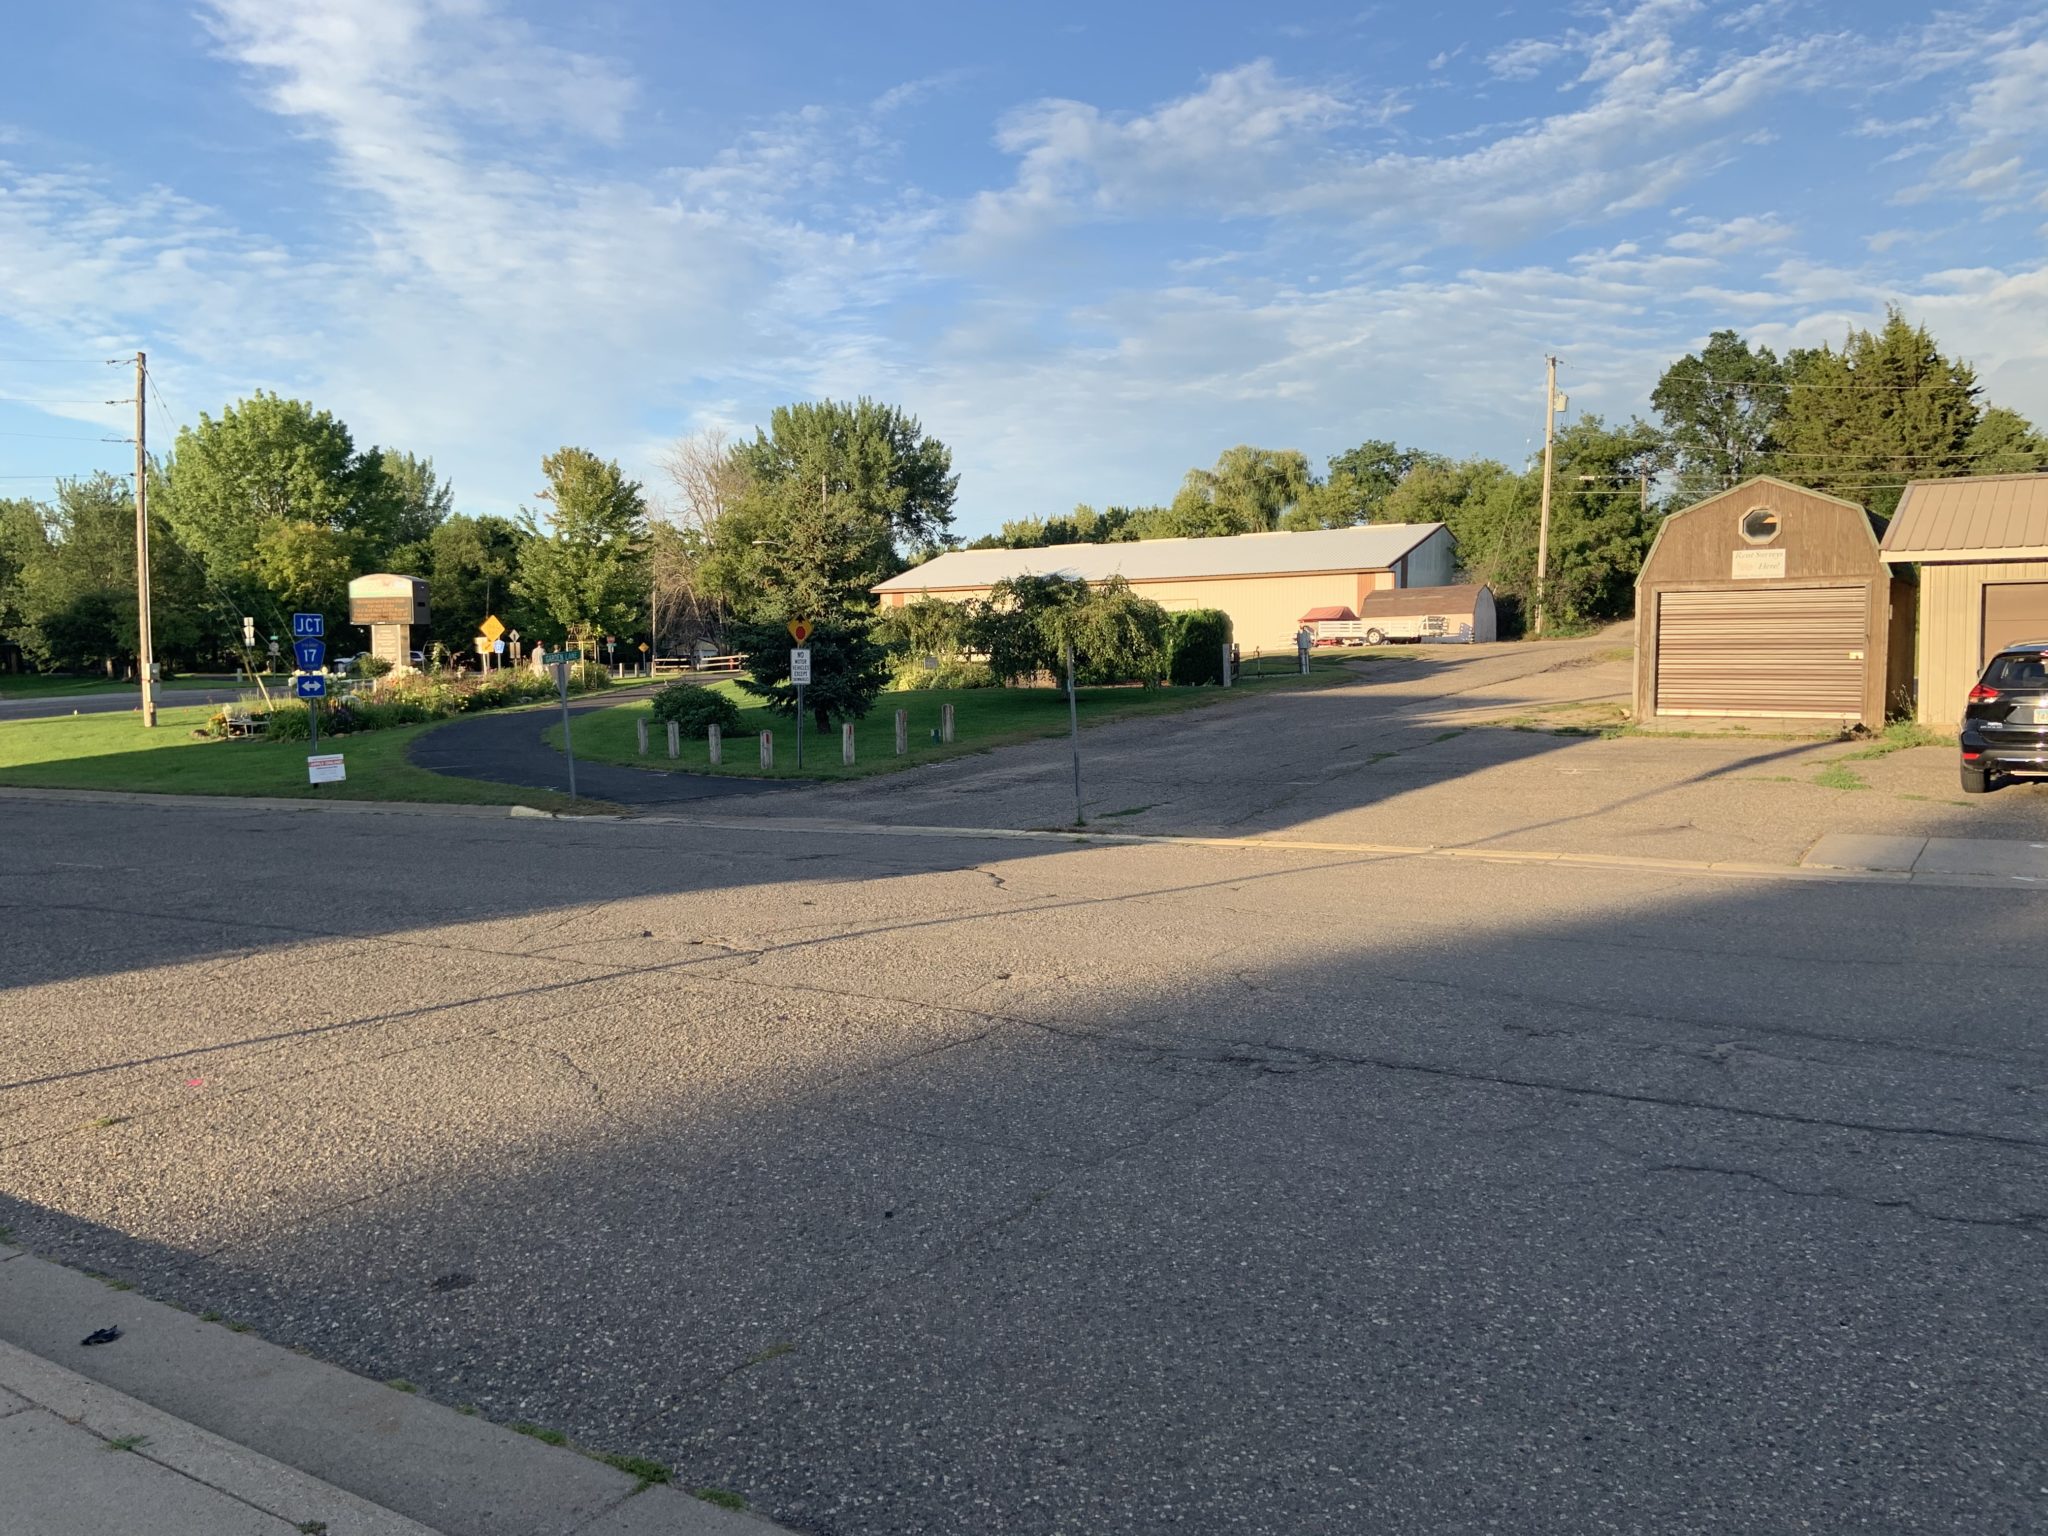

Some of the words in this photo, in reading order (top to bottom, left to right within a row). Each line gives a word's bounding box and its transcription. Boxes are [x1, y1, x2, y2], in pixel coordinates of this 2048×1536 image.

[1735, 552, 1754, 560] Rent
[297, 618, 321, 632] JCT
[303, 649, 317, 662] 17
